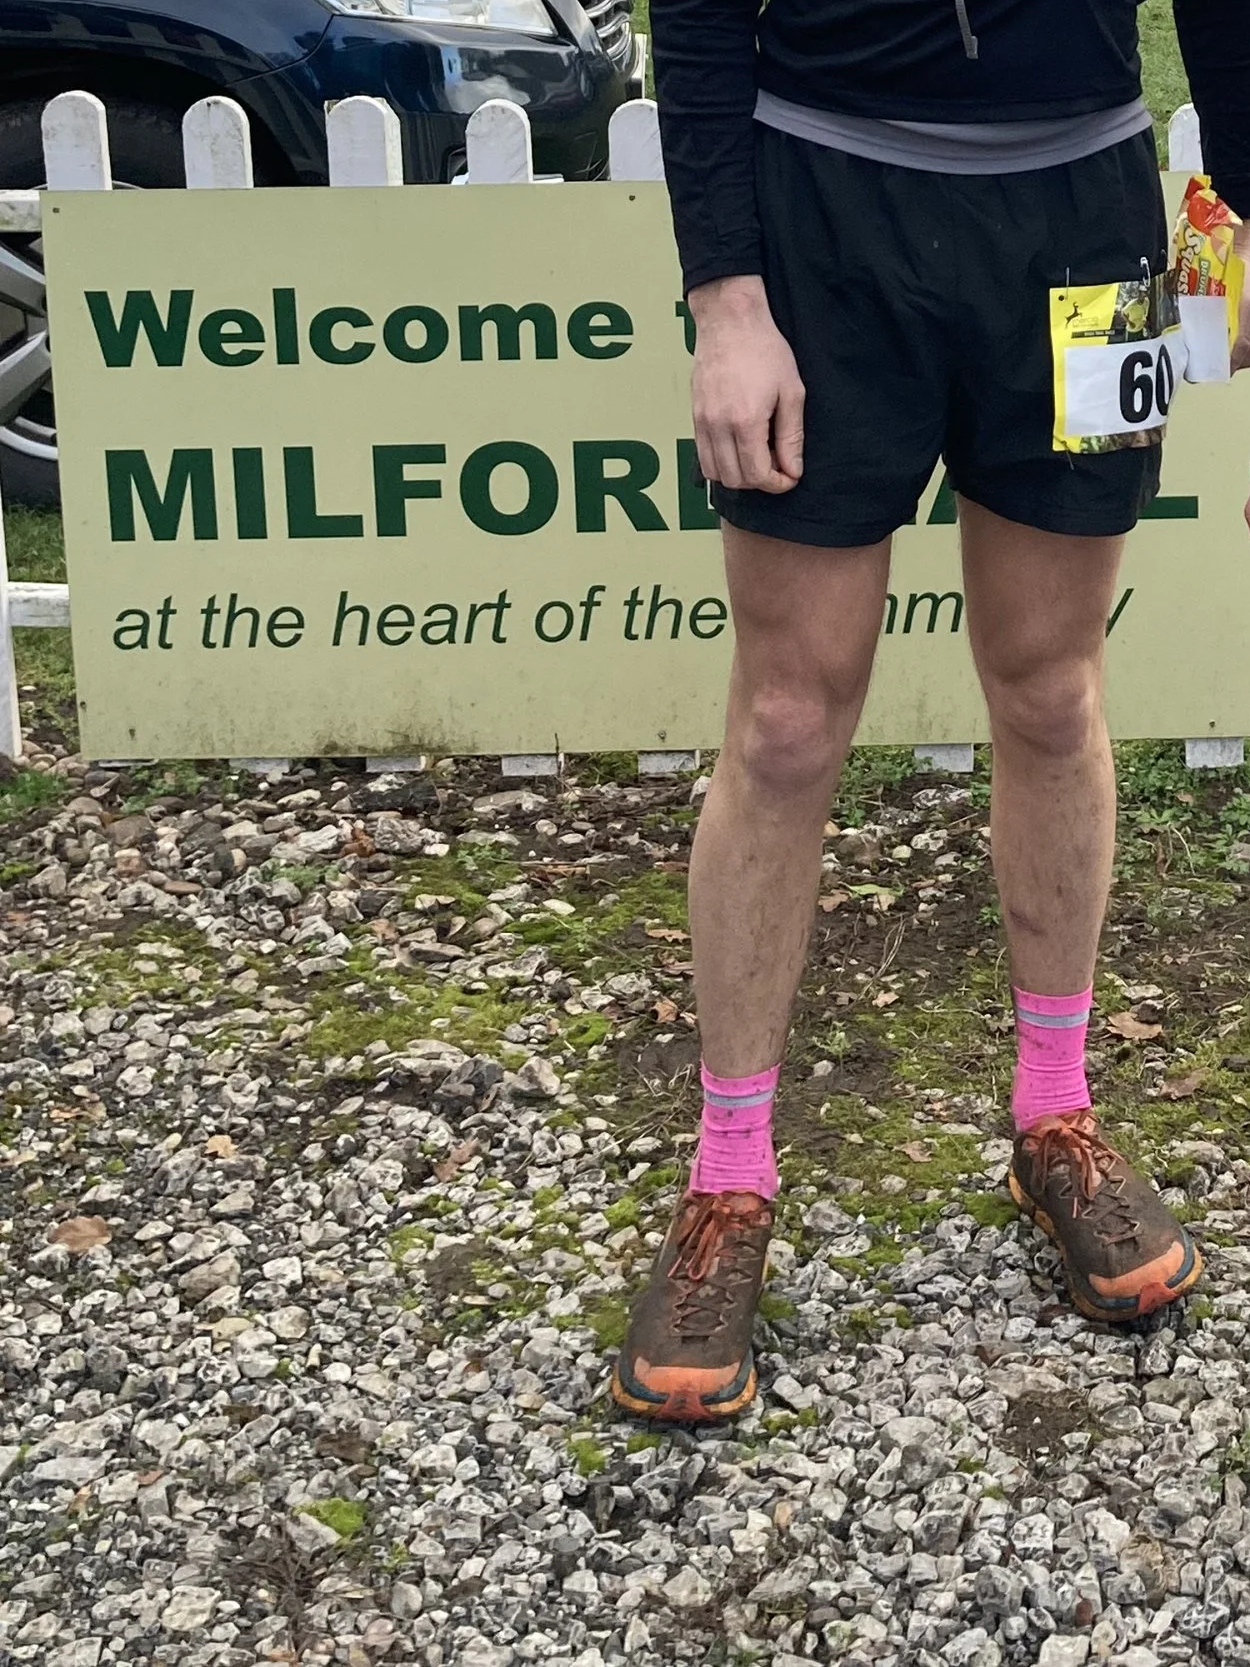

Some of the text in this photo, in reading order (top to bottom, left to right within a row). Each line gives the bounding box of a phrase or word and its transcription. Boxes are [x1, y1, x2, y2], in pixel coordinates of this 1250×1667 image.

[84, 288, 633, 368] Welcome
[1119, 344, 1174, 424] 60
[113, 584, 728, 651] at the heart of the
